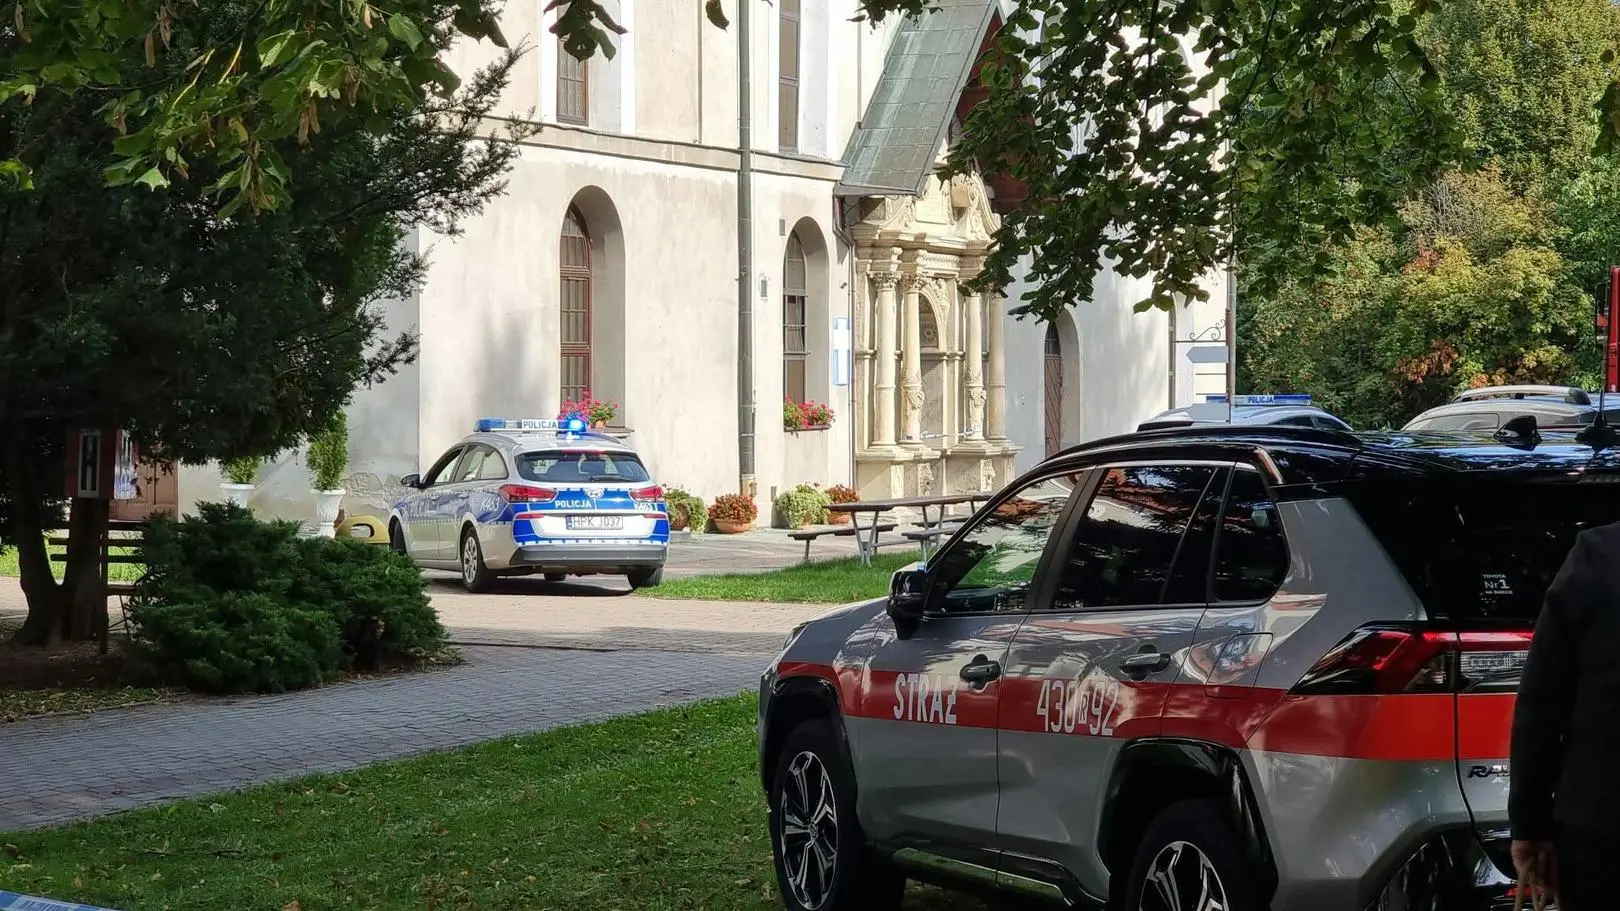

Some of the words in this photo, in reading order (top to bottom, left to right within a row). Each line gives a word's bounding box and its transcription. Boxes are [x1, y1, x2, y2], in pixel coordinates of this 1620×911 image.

[523, 420, 557, 429] POLICJA
[555, 500, 592, 509] POLICJA
[573, 515, 594, 527] HPK
